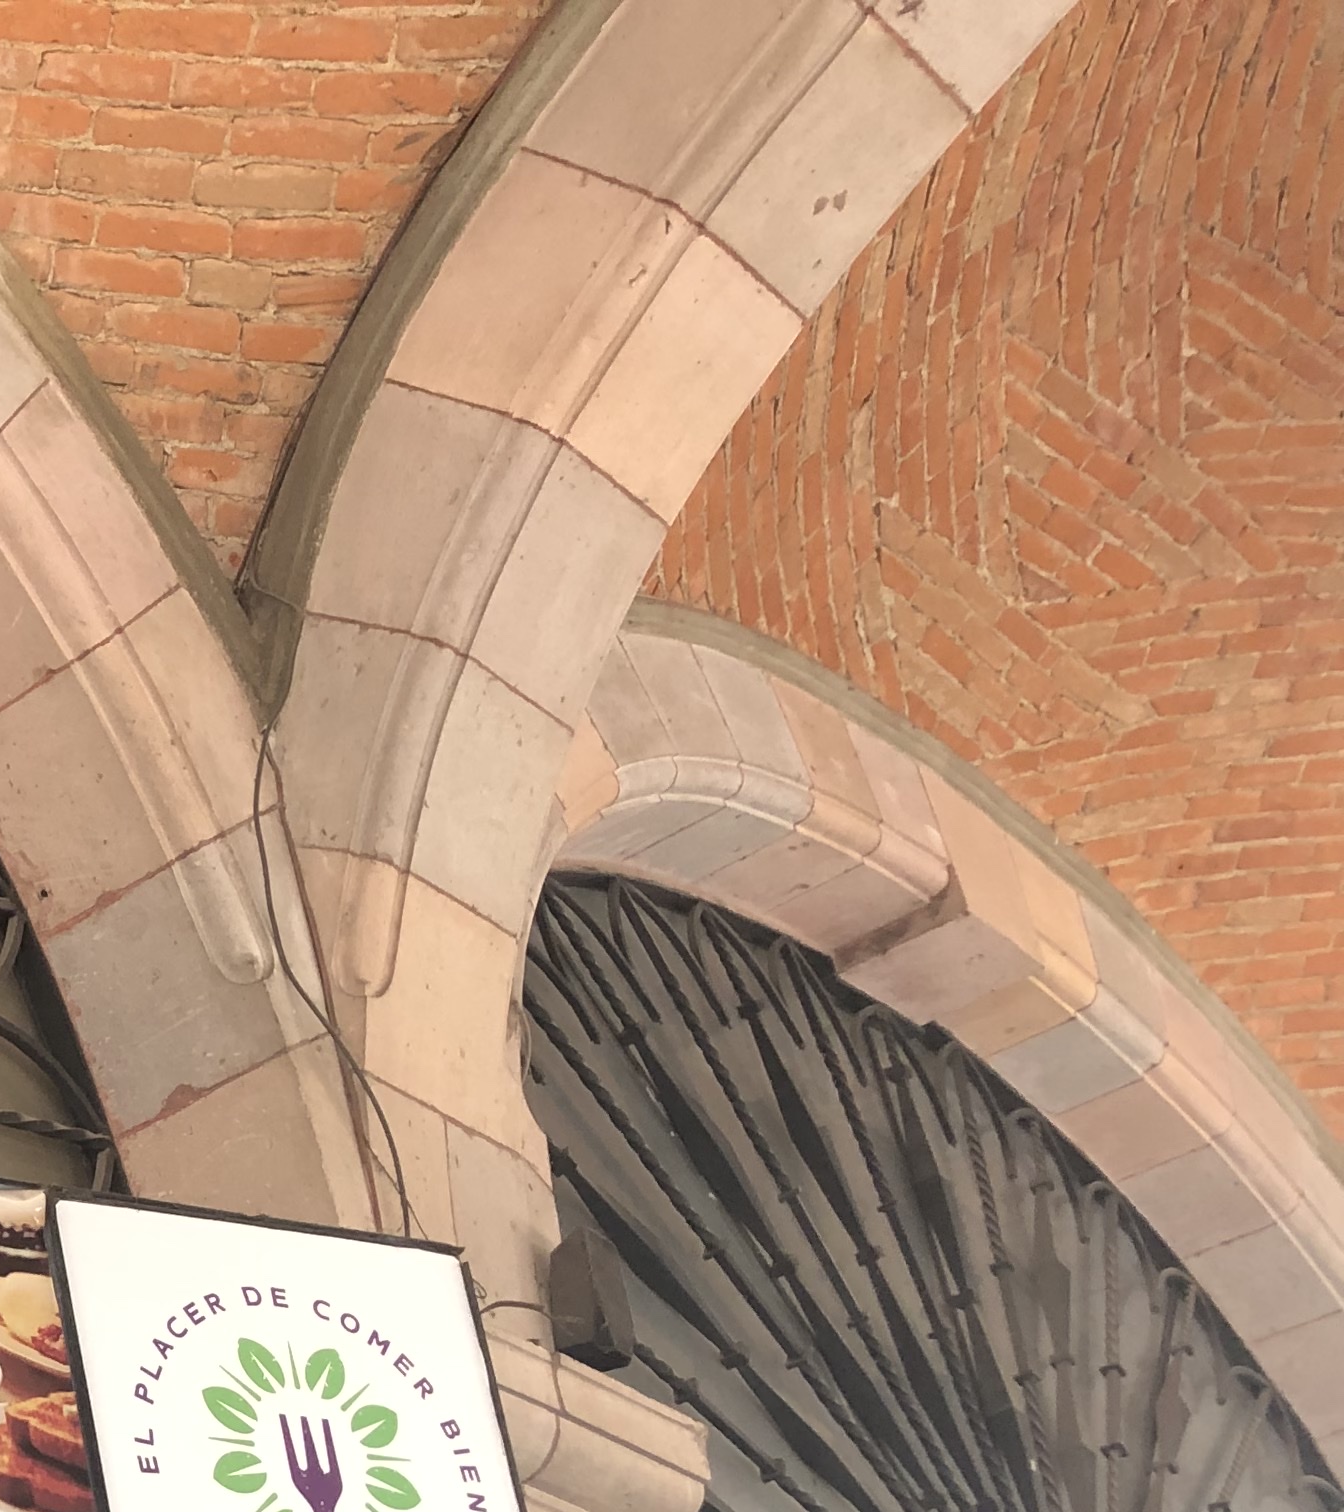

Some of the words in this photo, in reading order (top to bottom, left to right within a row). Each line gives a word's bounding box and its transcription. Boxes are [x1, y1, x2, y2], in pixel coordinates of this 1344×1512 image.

[241, 1286, 290, 1309] DE
[134, 1292, 225, 1404] PLACER
[313, 1300, 434, 1400] COMER
[135, 1428, 160, 1475] EL
[441, 1418, 487, 1512] BIEN
